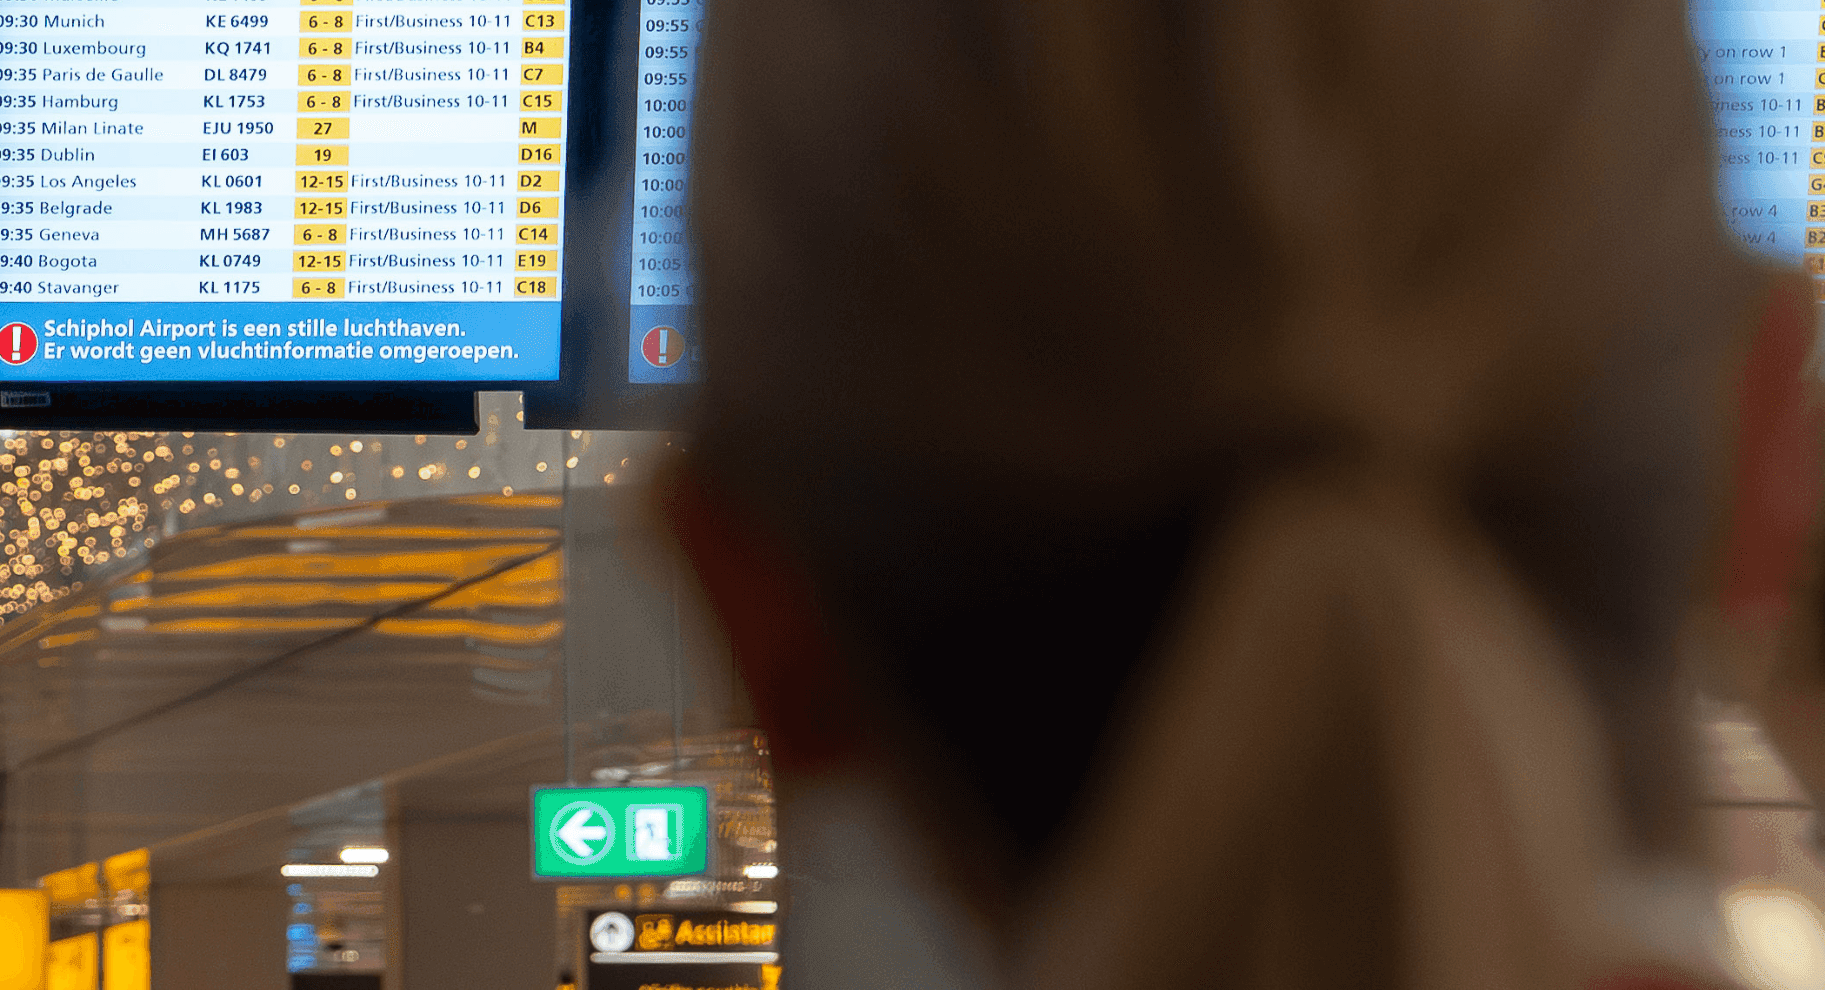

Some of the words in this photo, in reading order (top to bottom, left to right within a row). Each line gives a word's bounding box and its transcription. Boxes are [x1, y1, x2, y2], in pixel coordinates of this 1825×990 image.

[41, 147, 95, 162] Dublin
[202, 148, 217, 161] EI
[220, 148, 249, 161] 603
[314, 148, 332, 162] 19
[521, 148, 552, 161] D16
[44, 318, 134, 343] Schiphol
[139, 318, 216, 343] Airport
[222, 318, 238, 338] is
[241, 322, 282, 338] een
[287, 318, 338, 338] stille
[343, 317, 466, 338] luchthaven.
[43, 341, 66, 360] Er
[70, 340, 135, 360] wordt
[139, 344, 192, 364] geen
[197, 340, 374, 360] vluchtinformatie
[379, 344, 519, 364] omgeroepen.
